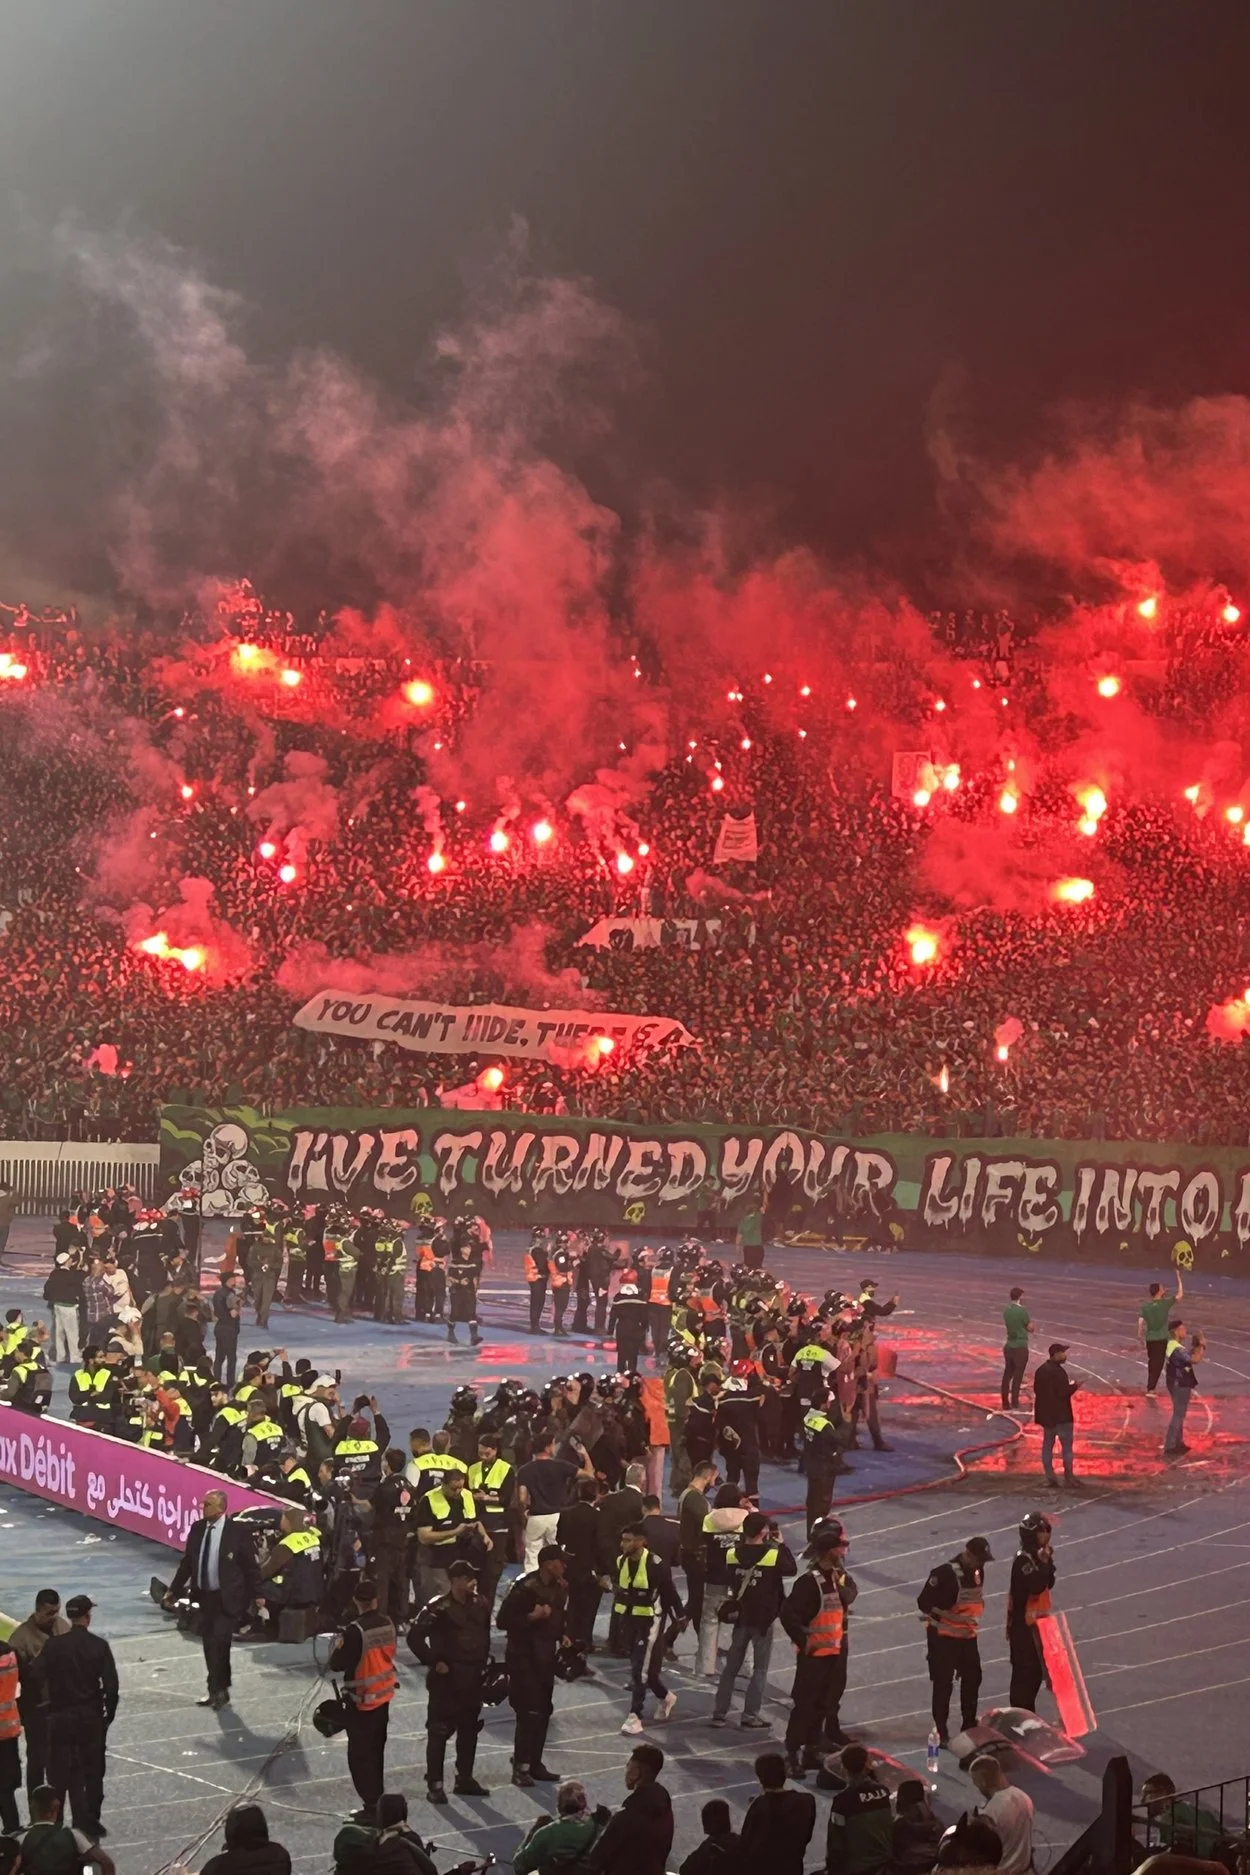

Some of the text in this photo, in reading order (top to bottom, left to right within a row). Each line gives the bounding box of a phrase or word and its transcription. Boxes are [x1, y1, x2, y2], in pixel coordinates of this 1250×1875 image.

[317, 999, 372, 1025] YOU
[376, 1010, 456, 1042] CAN'T
[287, 1129, 419, 1200] I'VE
[434, 1131, 707, 1204] TURNED
[721, 1131, 894, 1222] YOUR
[924, 1156, 1058, 1238] LIFE
[1072, 1167, 1220, 1246] INTO
[20, 1432, 76, 1499] Débit
[86, 1471, 105, 1509] مع
